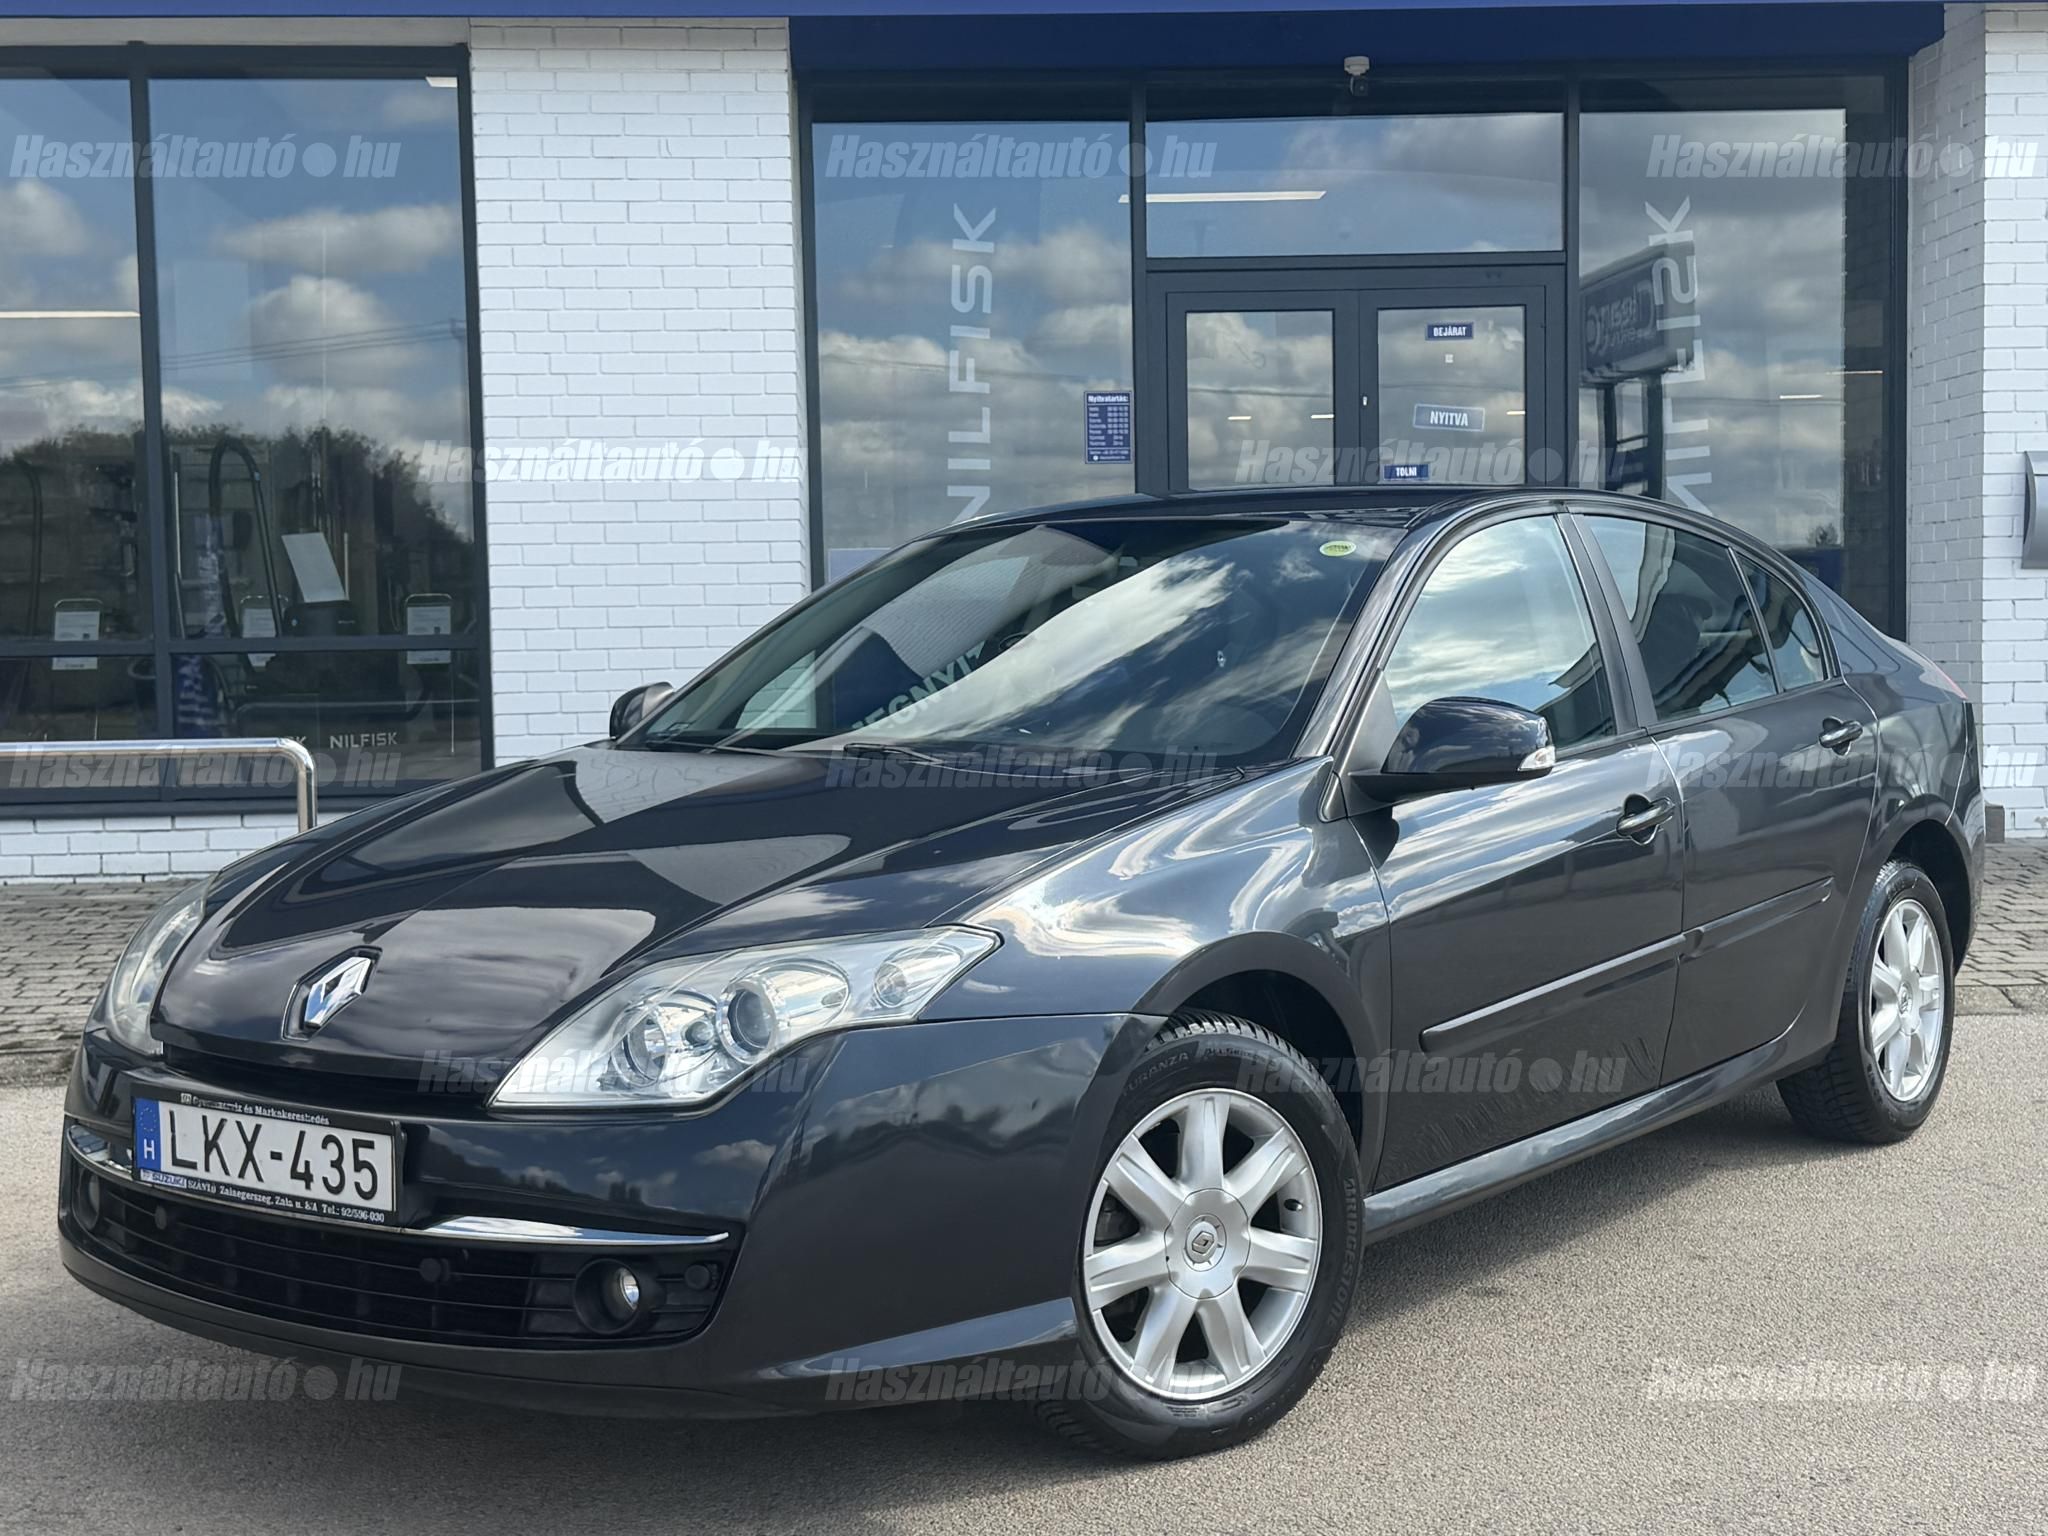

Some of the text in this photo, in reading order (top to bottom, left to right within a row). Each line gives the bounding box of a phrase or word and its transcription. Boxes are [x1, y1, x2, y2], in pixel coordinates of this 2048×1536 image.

[1433, 325, 1467, 337] BEJÁRAT
[1430, 410, 1469, 427] NYITVA
[1395, 467, 1417, 477] TOLNI
[329, 732, 398, 750] NILFISK
[143, 1138, 156, 1161] H
[169, 1110, 378, 1200] LKX-435
